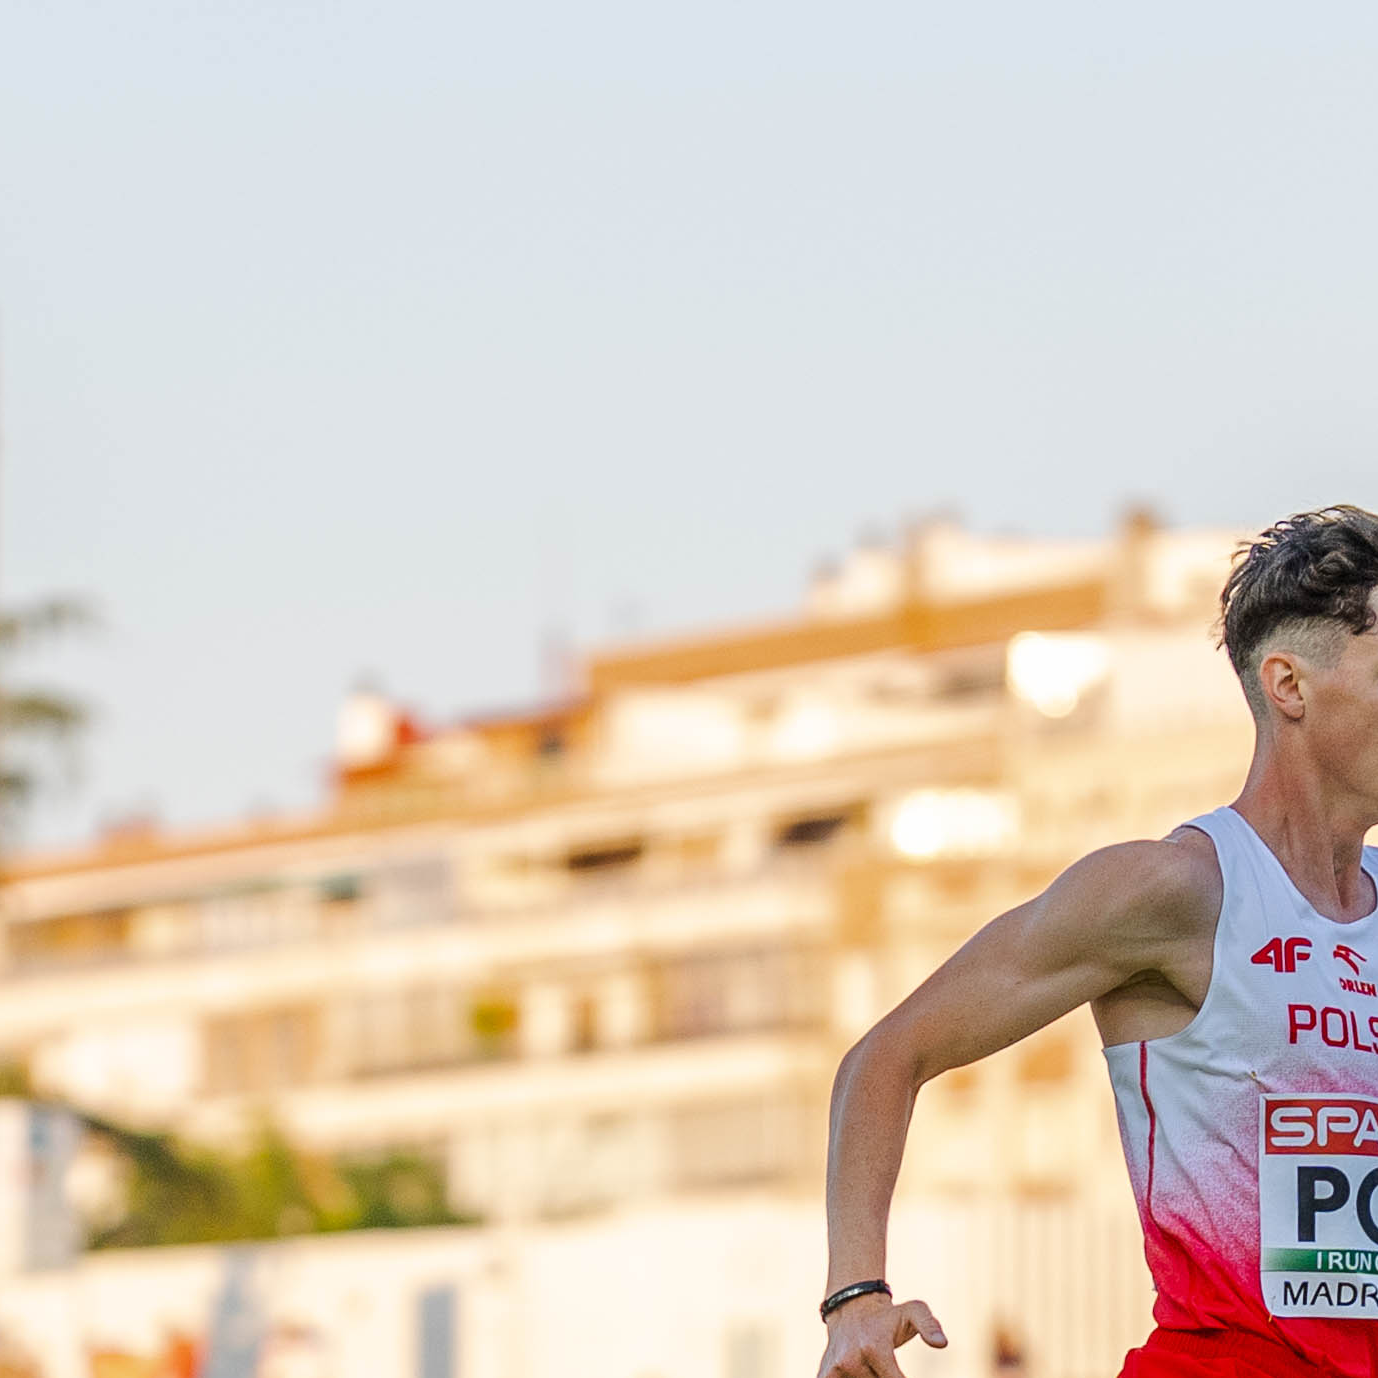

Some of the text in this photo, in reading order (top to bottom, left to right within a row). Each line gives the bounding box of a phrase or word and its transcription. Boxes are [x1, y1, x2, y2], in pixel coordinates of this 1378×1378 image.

[1251, 937, 1313, 973] 4F
[1339, 977, 1377, 997] ORLEN
[1328, 1252, 1371, 1271] RUN
